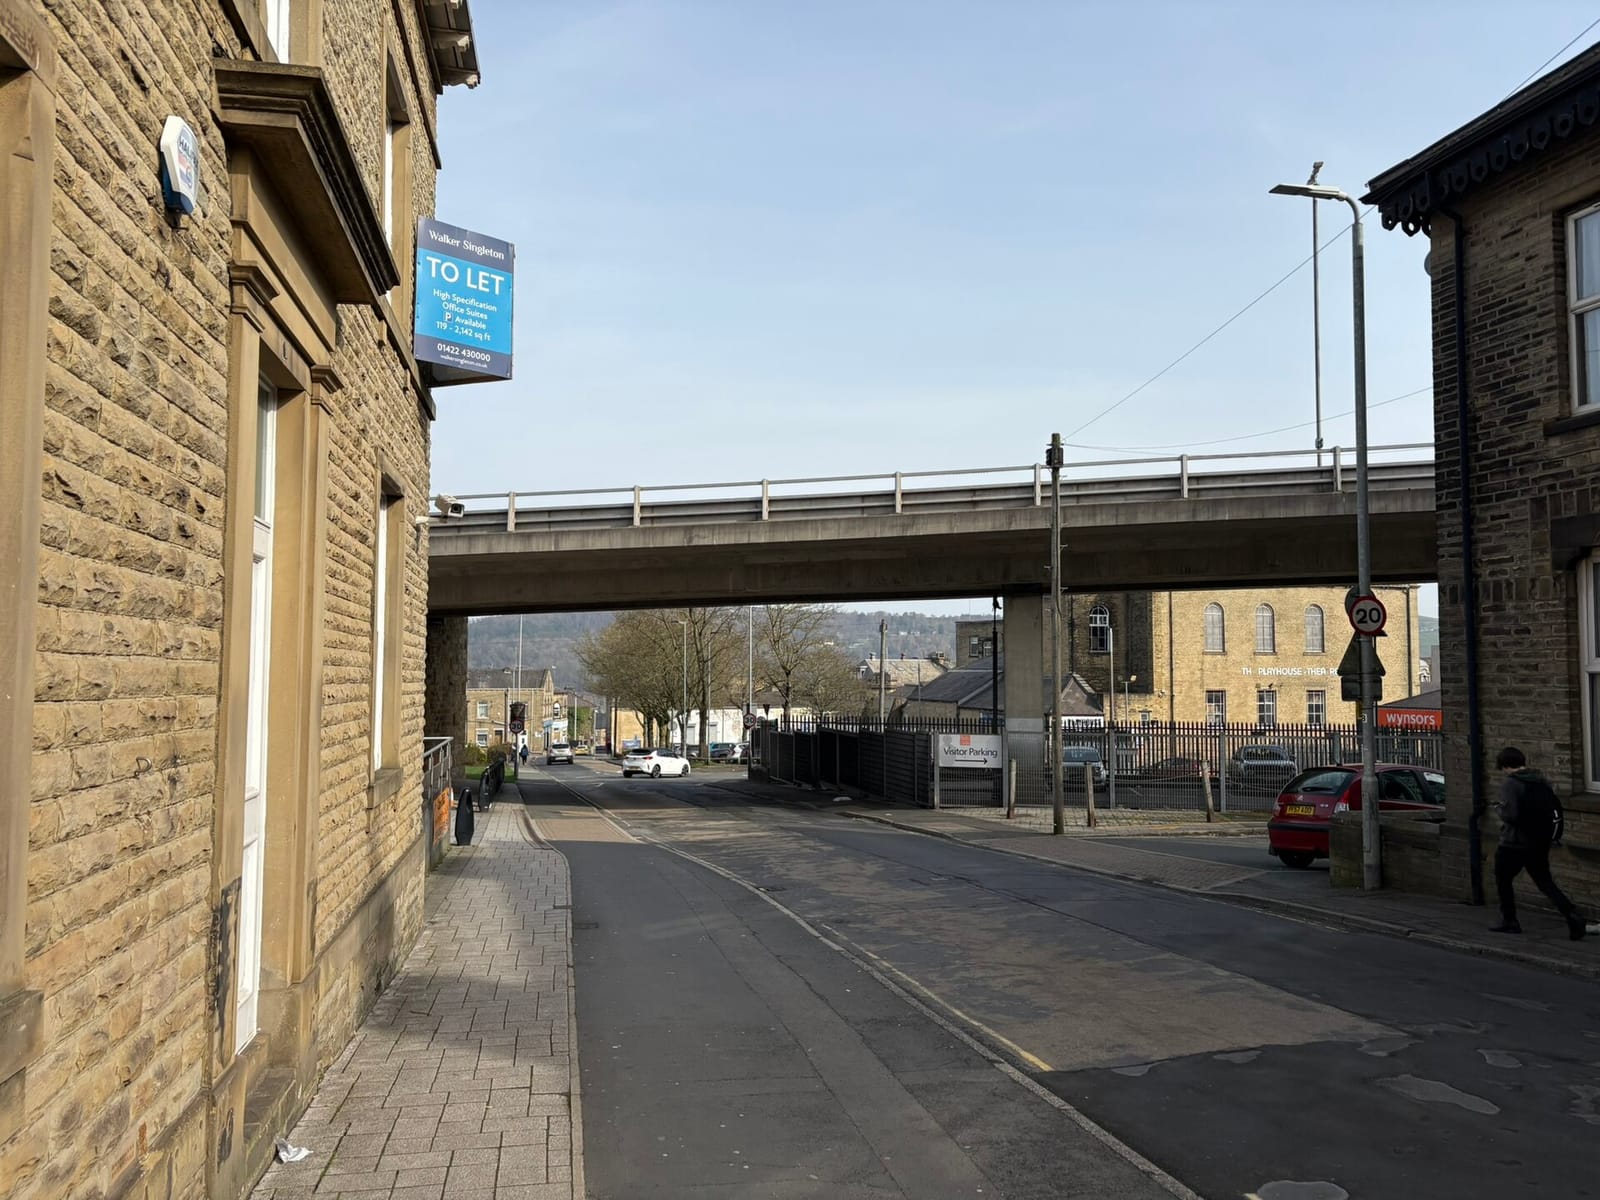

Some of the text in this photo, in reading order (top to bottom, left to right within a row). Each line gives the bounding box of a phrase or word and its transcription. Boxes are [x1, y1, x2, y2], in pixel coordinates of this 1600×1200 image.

[429, 229, 505, 260] Walker Singleton
[426, 255, 505, 296] TO LET
[433, 288, 497, 312] High Specification
[442, 301, 488, 320] Office Suites
[445, 311, 487, 330] P Available
[436, 320, 448, 330] 119
[454, 325, 473, 336] 2,142
[474, 331, 483, 342] sq
[484, 332, 491, 341] ft
[437, 343, 491, 362] 01422 430000
[1356, 607, 1382, 624] 20
[1258, 667, 1303, 675] PLAYHOUSE
[1386, 713, 1436, 725] wynsors
[943, 746, 998, 758] Visitor Parking
